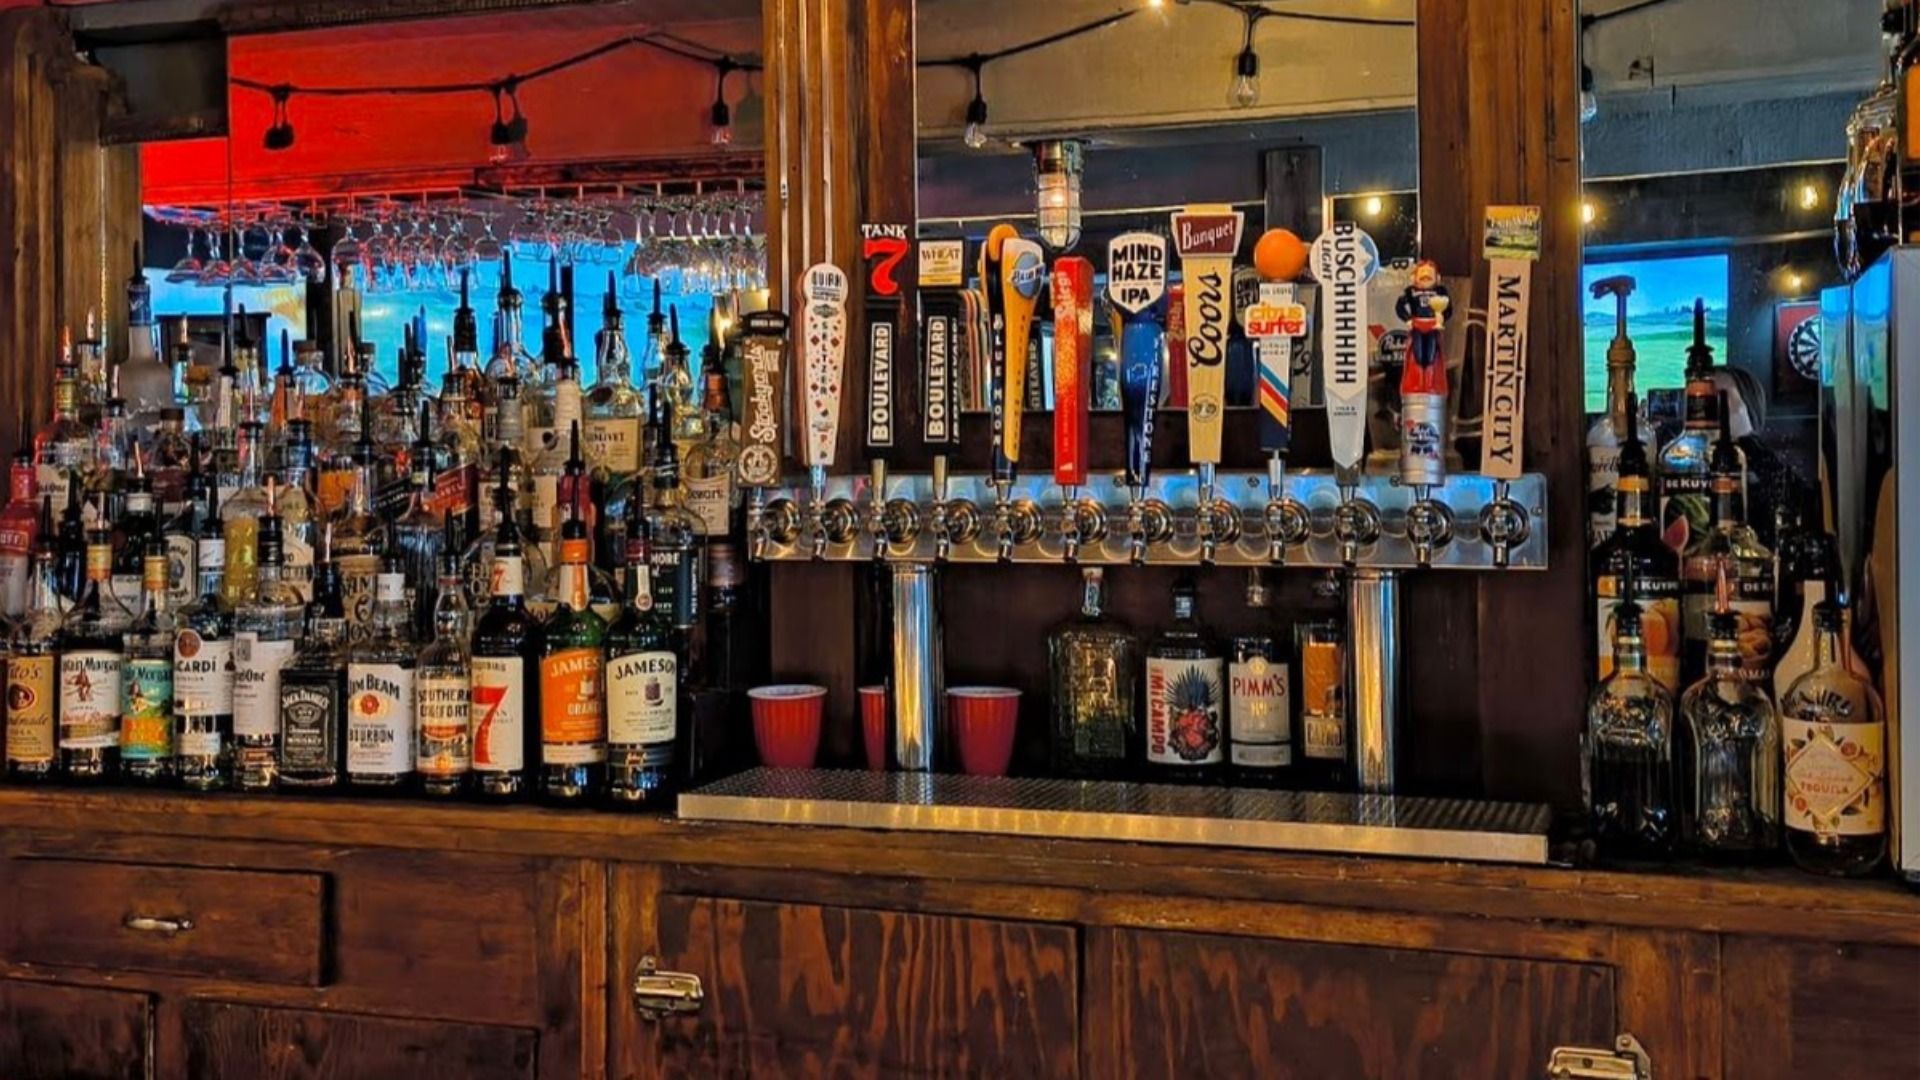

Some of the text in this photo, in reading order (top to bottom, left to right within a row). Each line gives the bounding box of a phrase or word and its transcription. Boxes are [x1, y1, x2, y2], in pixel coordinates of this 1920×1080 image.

[862, 223, 909, 240] TANK
[1182, 220, 1234, 250] Banquet
[863, 237, 911, 296] 7
[920, 247, 962, 261] WHEAT
[1112, 243, 1163, 264] MIND
[1322, 239, 1333, 281] LIGHT
[1112, 262, 1163, 282] HAZE
[1121, 286, 1150, 304] IPA
[1190, 270, 1222, 369] Coors
[1249, 301, 1303, 320] citrus
[1248, 316, 1305, 335] surfer
[872, 326, 889, 441] BOULEVARD
[928, 321, 945, 436] BOULEVARD
[1490, 275, 1521, 465] MARTIN CITY
[744, 343, 778, 444] Stockyards
[366, 673, 400, 700] BEAM
[1232, 673, 1286, 697] PIMM'S
[473, 684, 509, 765] 7
[1801, 782, 1849, 794] TEQUILA
